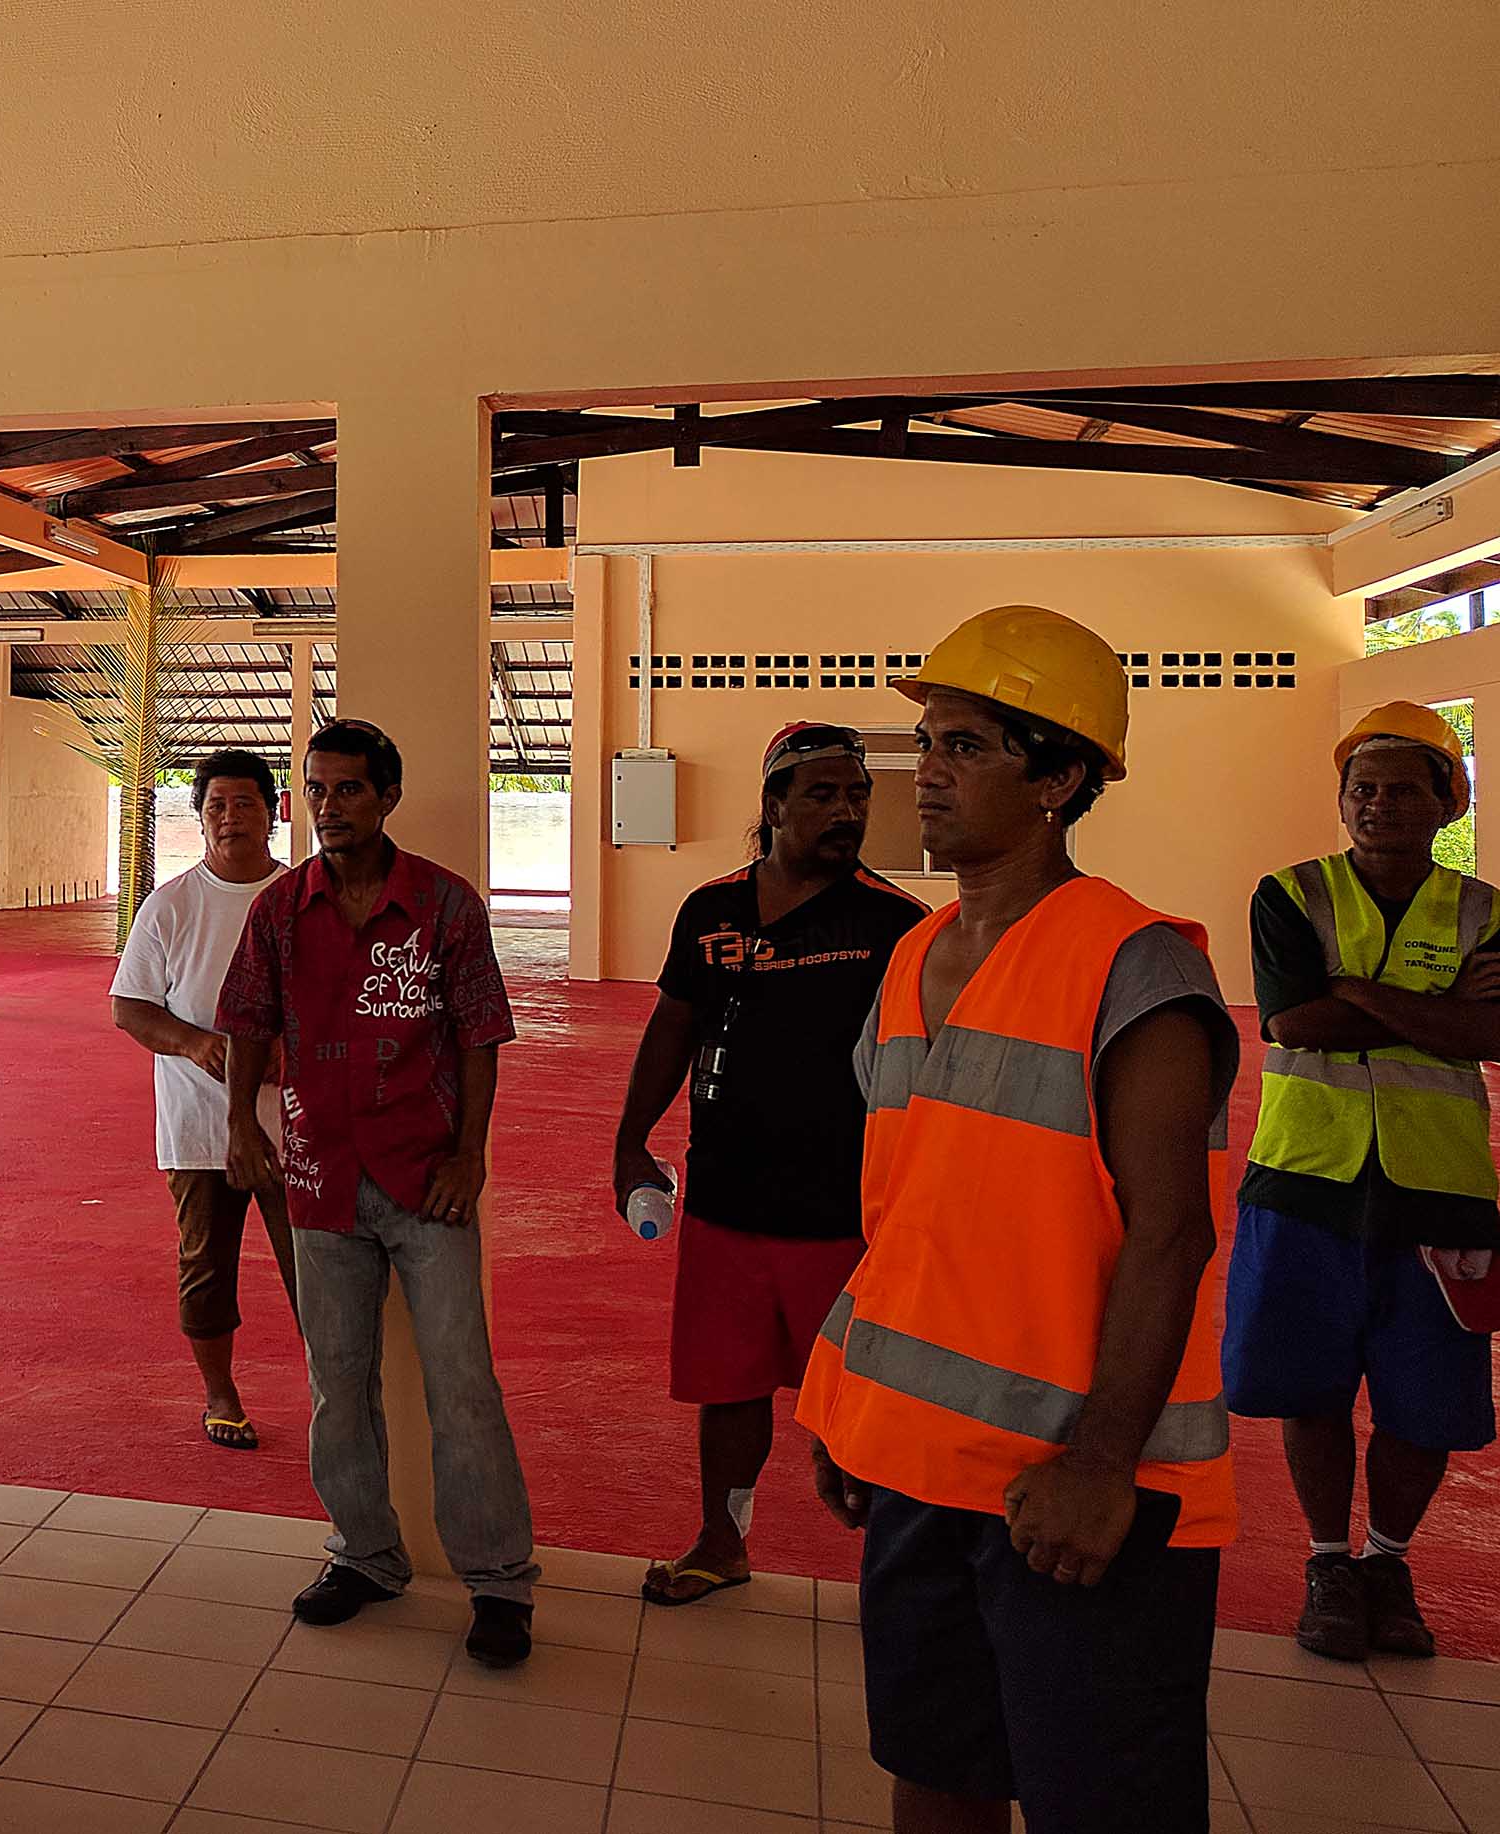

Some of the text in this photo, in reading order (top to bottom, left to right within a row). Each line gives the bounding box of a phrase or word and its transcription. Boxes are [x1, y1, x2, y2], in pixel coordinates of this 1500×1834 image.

[1404, 940, 1457, 953] COMMUNE
[1423, 952, 1437, 961] DE
[363, 973, 392, 996] OF
